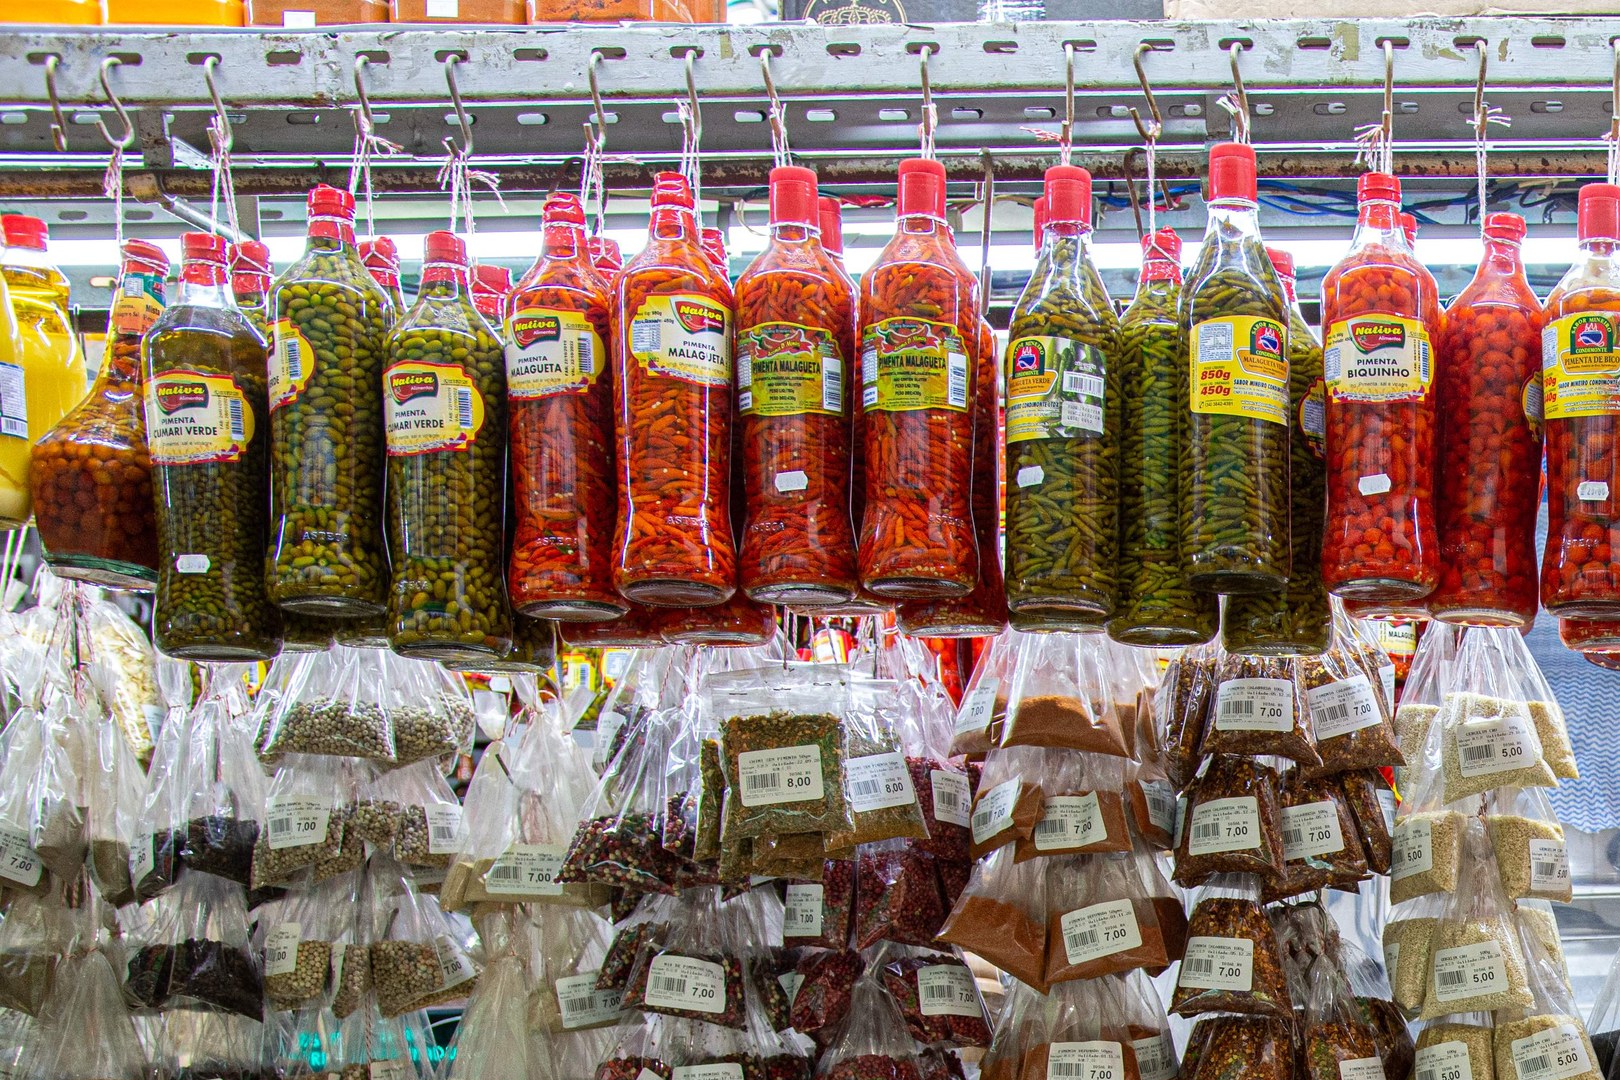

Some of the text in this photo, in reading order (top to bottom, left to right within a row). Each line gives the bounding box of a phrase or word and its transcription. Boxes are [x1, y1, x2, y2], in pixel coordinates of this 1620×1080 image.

[680, 305, 723, 320] Nativa
[514, 320, 557, 331] Nativa
[1355, 327, 1402, 337] Nativa
[683, 340, 716, 350] PIMENTA
[879, 357, 946, 368] PIMENTA MALAGUETA
[1244, 357, 1276, 369] MALAGUETA
[1357, 358, 1398, 366] PIMENTA
[1564, 357, 1591, 365] PIMENTA
[1601, 355, 1620, 363] BICO
[511, 364, 561, 377] MALAGUETA
[753, 361, 820, 374] PIMENTA MALAGUETA
[1347, 368, 1410, 378] BIQUINHO
[393, 375, 435, 386] Nativa
[1201, 370, 1231, 380] 850g
[158, 386, 205, 396] Nativa
[1201, 385, 1230, 395] 450g
[395, 409, 426, 417] PIMENTA
[388, 419, 444, 431] CUMARI VERDE
[154, 426, 217, 438] CUMARI VERDE
[1259, 707, 1282, 718] 7,00
[1501, 746, 1523, 758] 5,00
[787, 777, 811, 788] 8,00
[296, 820, 316, 833] 7,00
[1073, 822, 1092, 834] 7,00
[1225, 826, 1248, 837] 7,00
[1308, 830, 1331, 842] 7,00
[527, 871, 552, 883] 7,00
[1104, 928, 1127, 941] 7,00
[1218, 967, 1241, 978] 7,00
[1472, 970, 1495, 983] 5,00
[692, 987, 715, 999] 7,00
[1557, 1053, 1578, 1066] 5,00
[1090, 1069, 1112, 1080] 7,00
